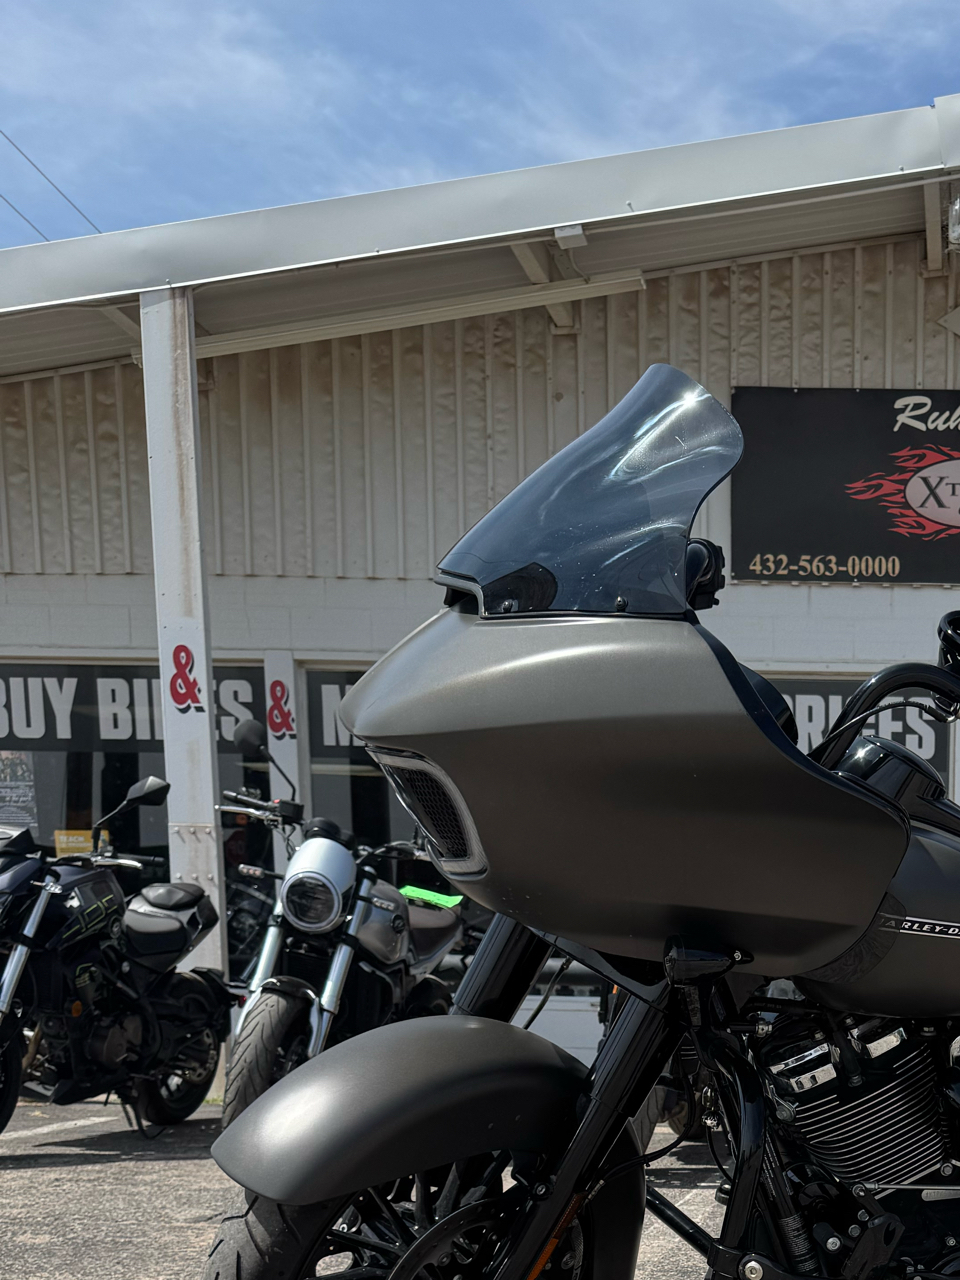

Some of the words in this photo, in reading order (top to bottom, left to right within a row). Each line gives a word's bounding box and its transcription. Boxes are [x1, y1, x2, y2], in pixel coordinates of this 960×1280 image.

[749, 554, 900, 578] 432-563-0000
[0, 677, 78, 739] UY
[97, 678, 253, 742] BIS
